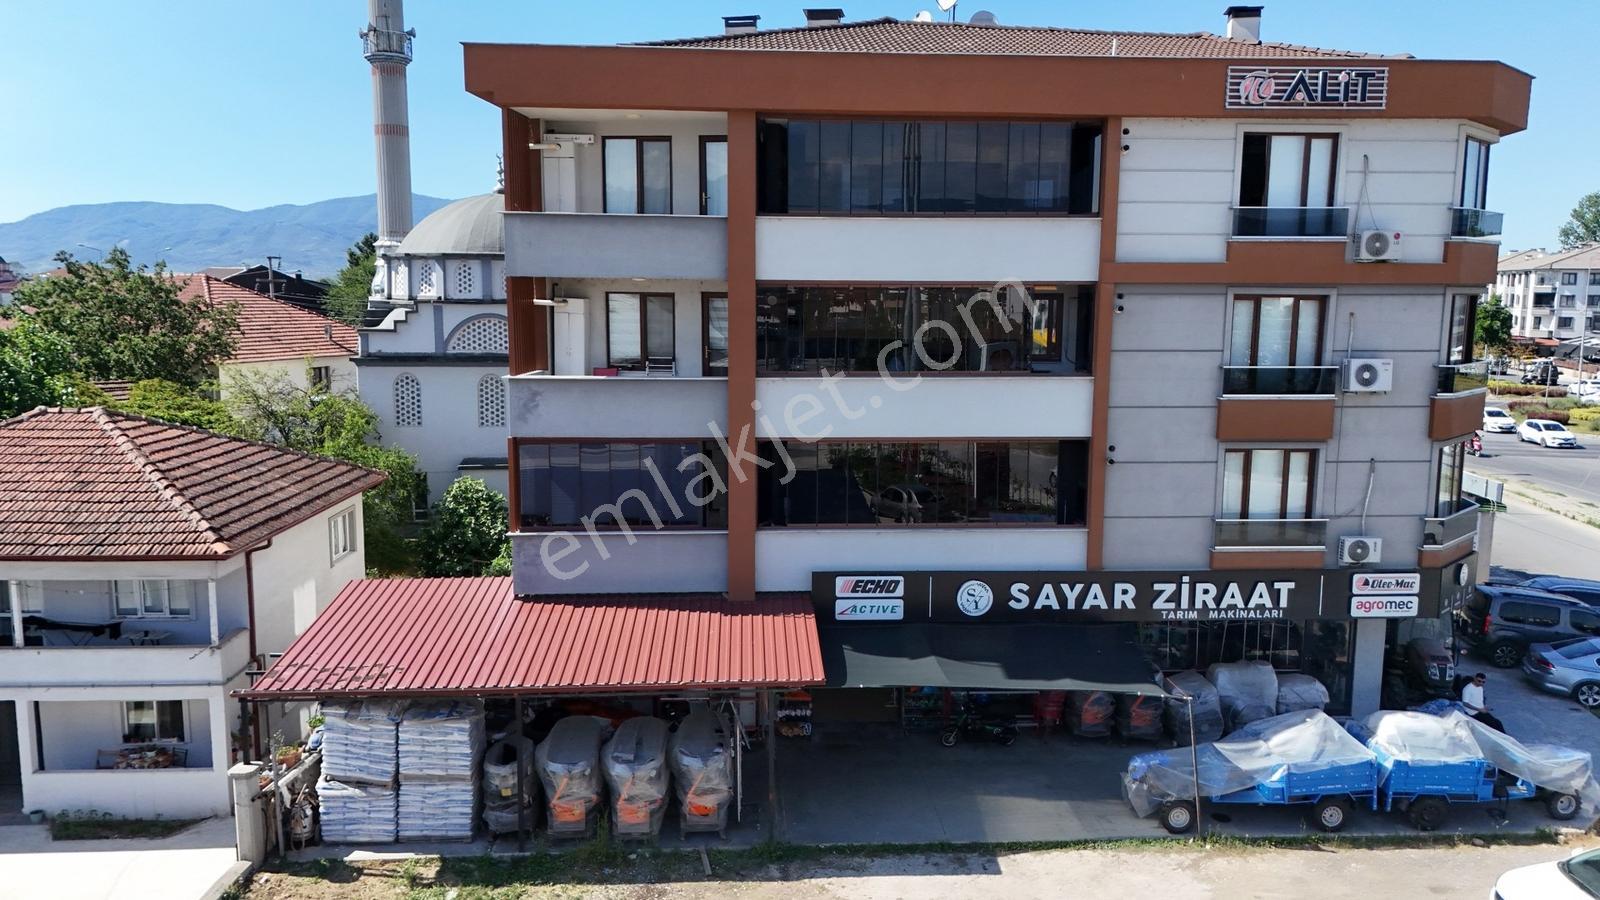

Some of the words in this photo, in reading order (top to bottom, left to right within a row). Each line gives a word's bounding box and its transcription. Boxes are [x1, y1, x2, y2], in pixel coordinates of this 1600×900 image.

[850, 579, 901, 594] ECHO
[1008, 582, 1137, 610] SAYAR
[1152, 576, 1295, 610] ZİRAAT
[849, 605, 901, 614] ACTIVE
[1356, 600, 1413, 613] agromec
[1161, 610, 1198, 620] TARIM
[1209, 609, 1284, 619] MAKİNALARI
